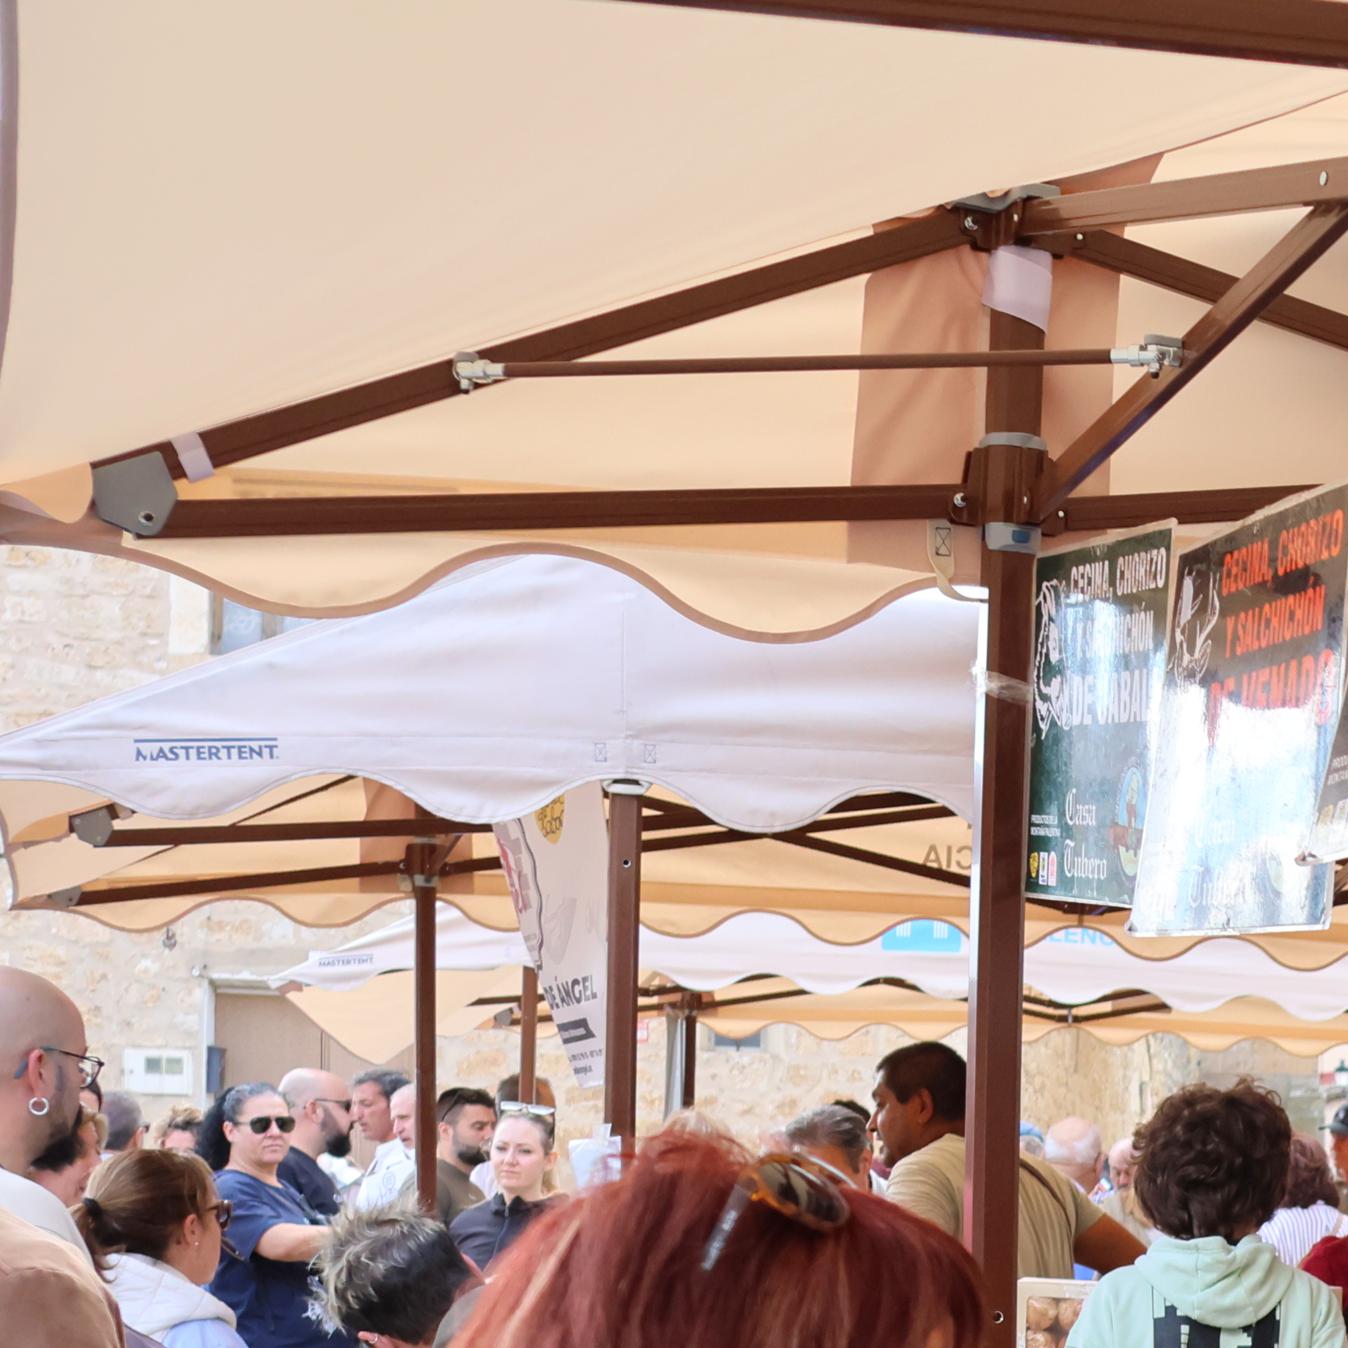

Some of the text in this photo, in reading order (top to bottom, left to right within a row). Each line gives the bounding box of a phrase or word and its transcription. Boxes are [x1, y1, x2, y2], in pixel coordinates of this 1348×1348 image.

[1116, 547, 1167, 596] CHORIZO
[1221, 509, 1344, 597] CECINA, CHORIZO
[1226, 575, 1326, 658] Y SALCHICHÓN
[134, 744, 279, 762] MASTERTENT
[1065, 788, 1097, 826] Casa
[1063, 839, 1107, 880] Tubero
[555, 975, 598, 1009] ÁNGEL
